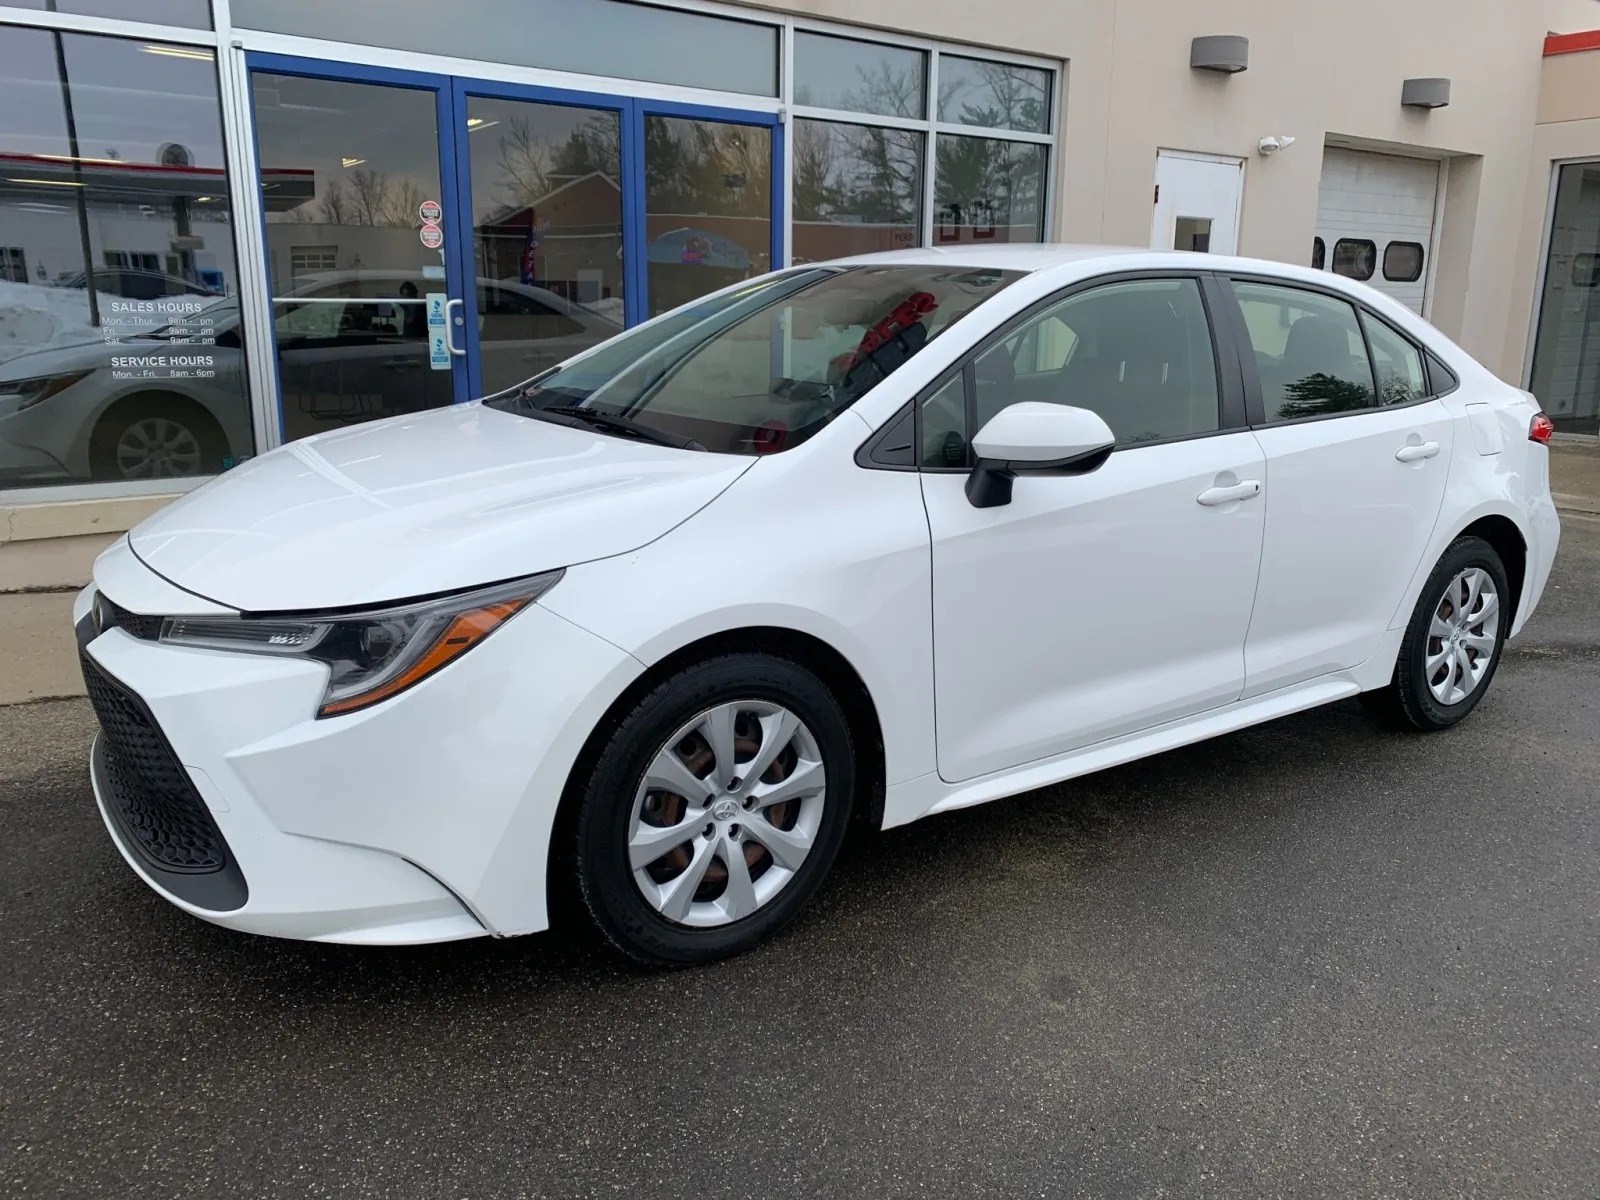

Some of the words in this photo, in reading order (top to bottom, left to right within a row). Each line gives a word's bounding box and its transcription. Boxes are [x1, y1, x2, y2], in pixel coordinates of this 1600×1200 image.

[111, 302, 154, 312] SALES
[157, 302, 202, 312] HOURS
[168, 316, 187, 325] 9am
[200, 318, 213, 326] pm
[168, 326, 188, 335] 9am
[170, 336, 189, 344] 9am
[202, 337, 215, 345] pm
[111, 356, 167, 367] SERVICE
[170, 355, 213, 366] HOURS
[170, 369, 189, 377] 8am
[196, 369, 215, 378] 6pm
